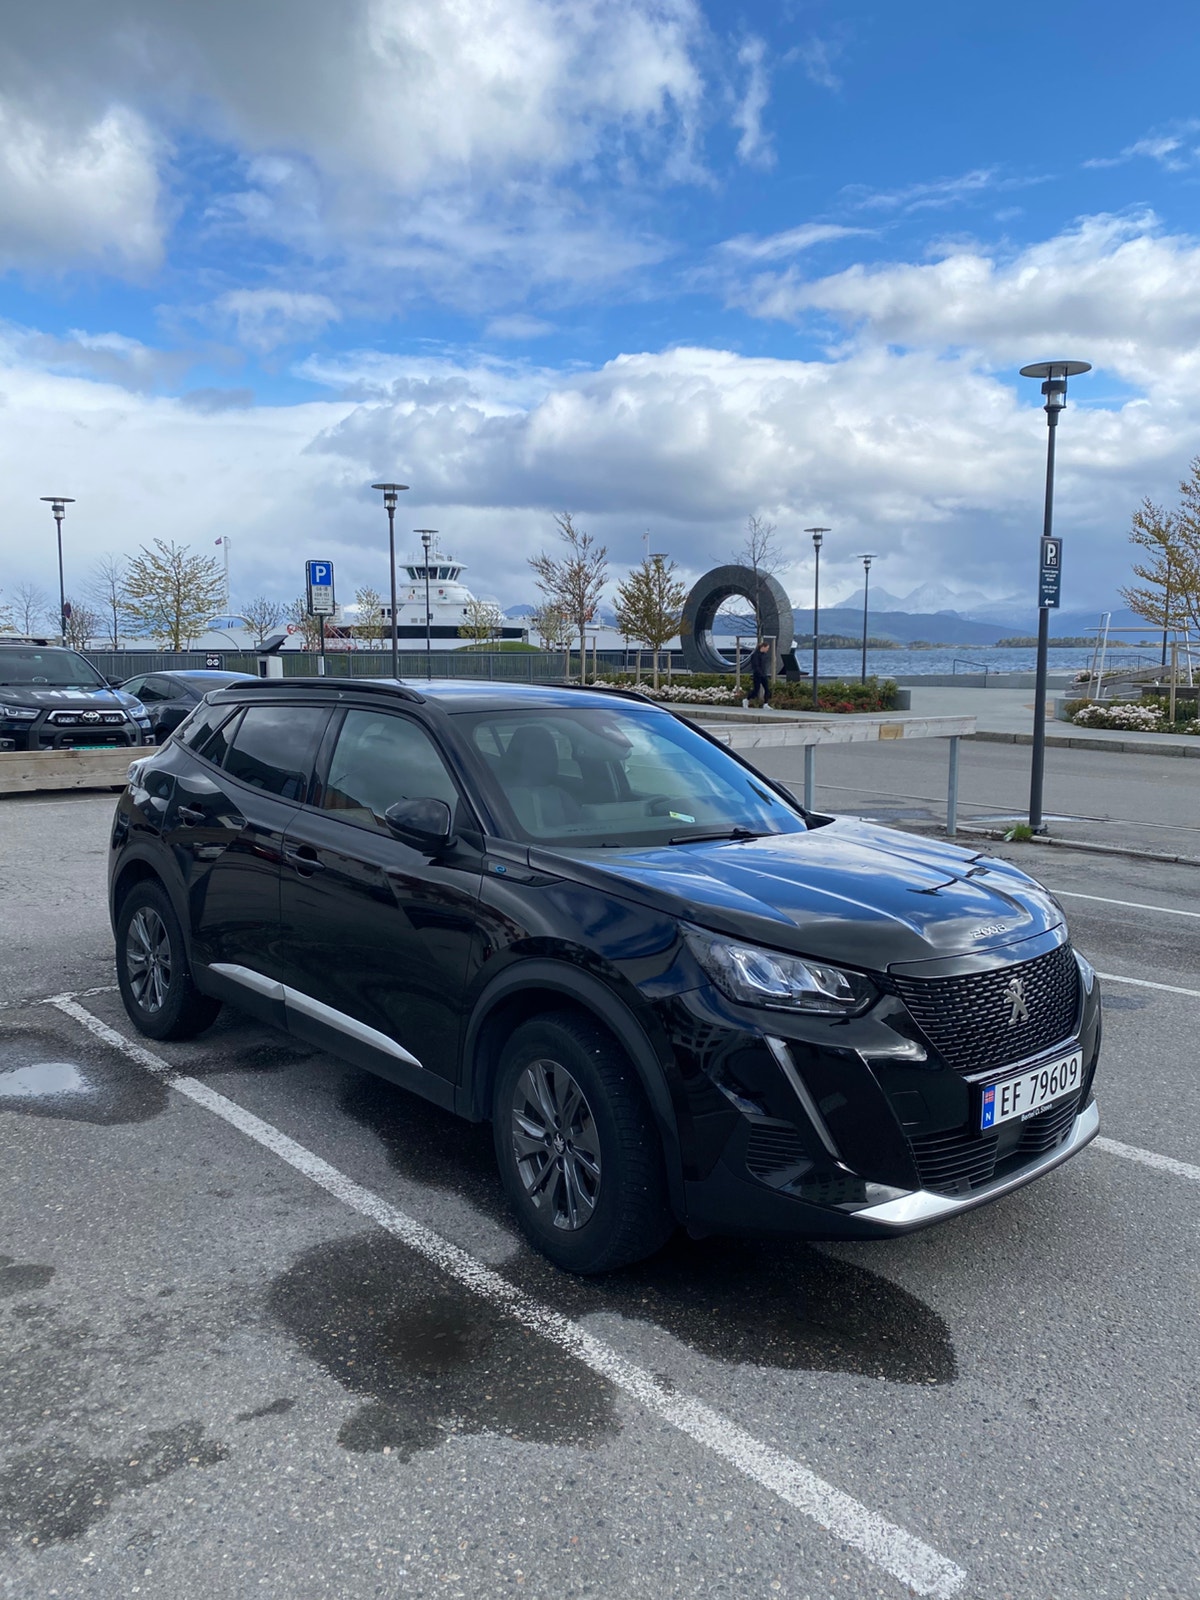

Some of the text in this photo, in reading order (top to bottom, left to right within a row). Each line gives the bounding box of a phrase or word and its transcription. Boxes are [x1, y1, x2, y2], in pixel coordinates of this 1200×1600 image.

[1047, 543, 1056, 565] P
[315, 565, 327, 583] P
[969, 923, 1006, 939] 2008
[1001, 1057, 1078, 1117] EF 79609
[985, 1111, 992, 1122] N
